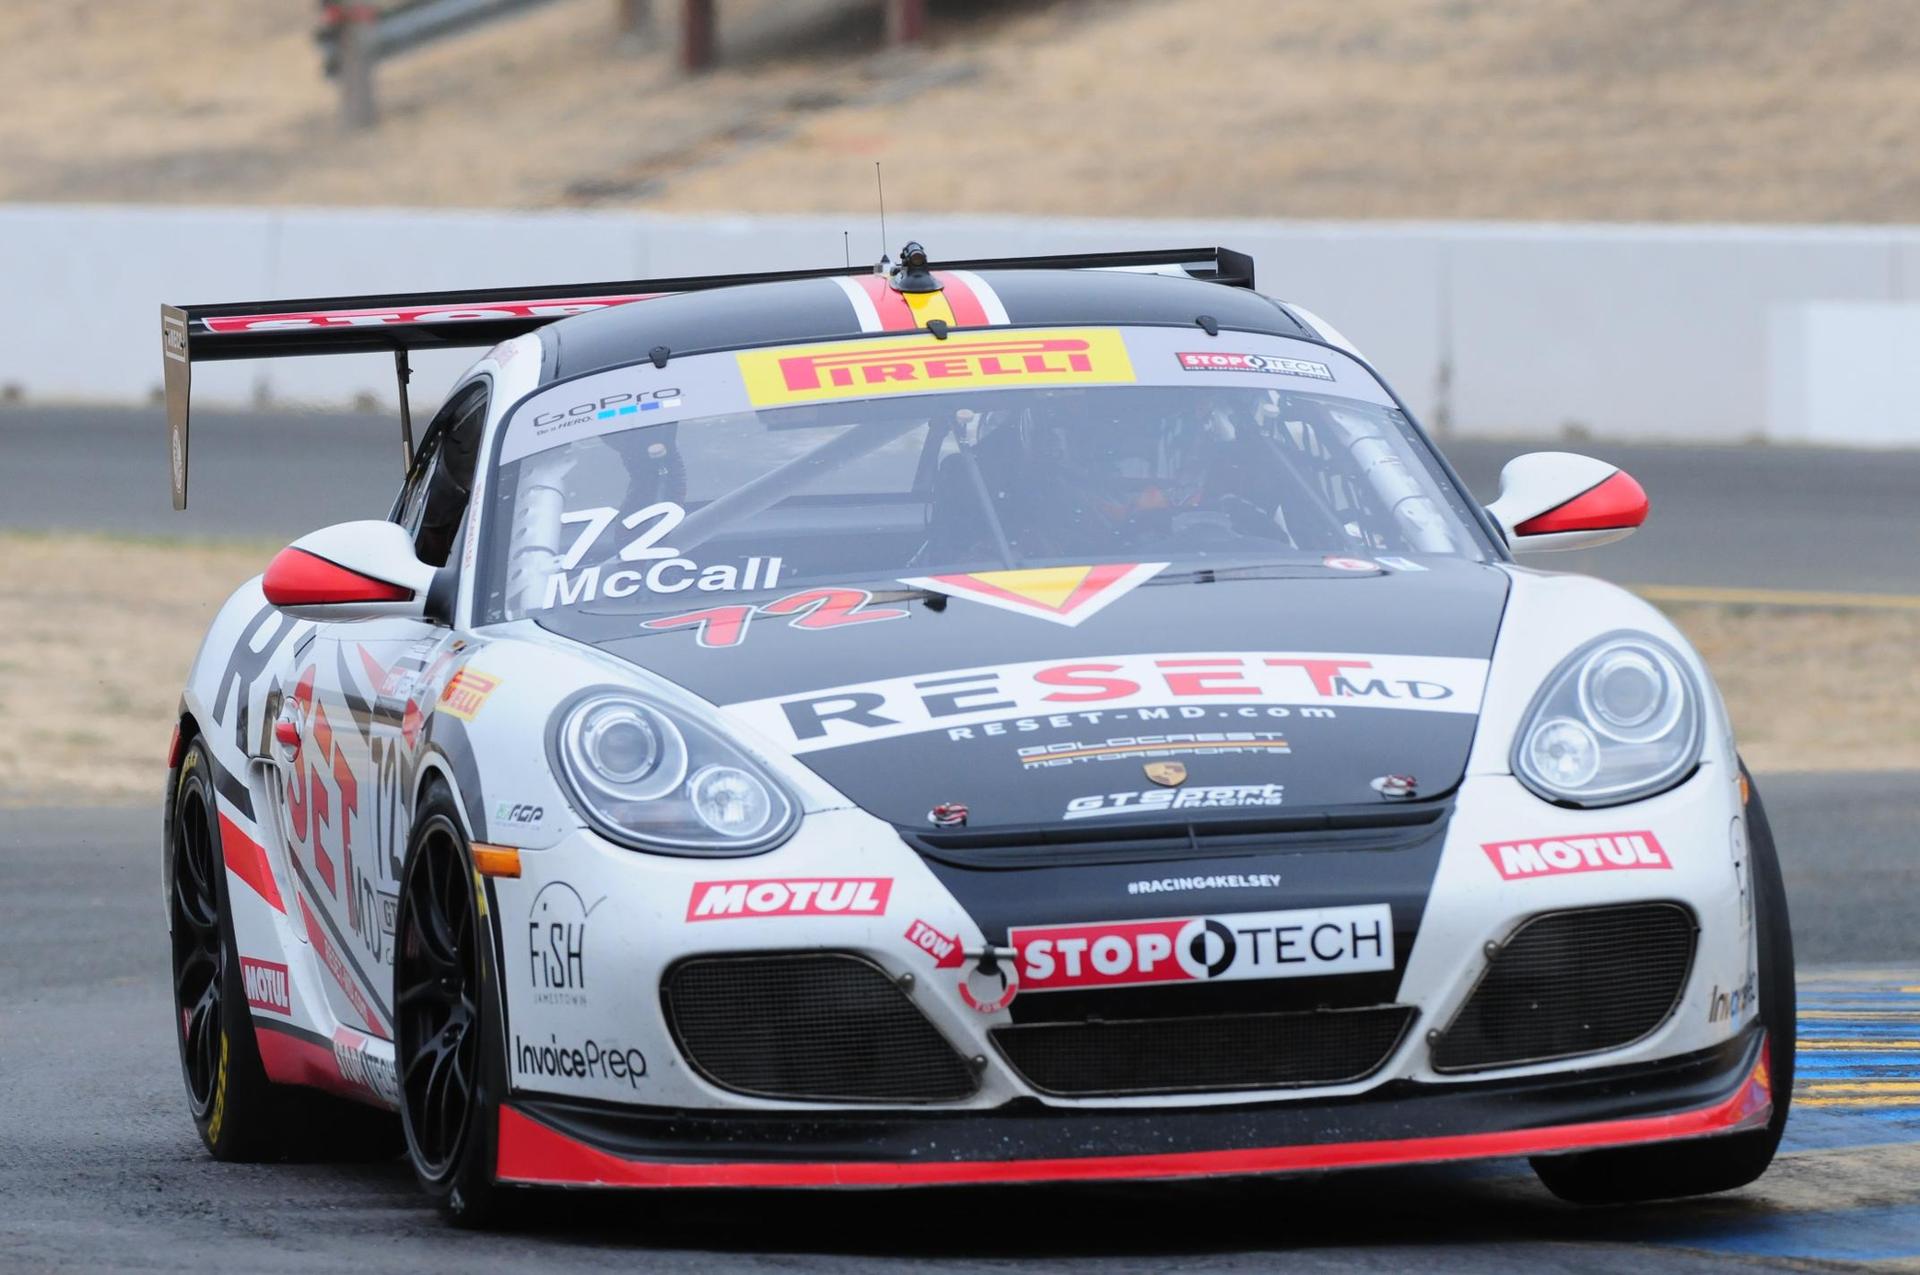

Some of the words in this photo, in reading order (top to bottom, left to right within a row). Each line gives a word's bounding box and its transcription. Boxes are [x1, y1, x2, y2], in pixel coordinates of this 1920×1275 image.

[777, 338, 1092, 391] PIRELLI
[1185, 355, 1244, 367] STOP
[1268, 358, 1326, 375] TECH
[533, 388, 681, 427] GoPro
[560, 501, 686, 570] 72
[541, 557, 783, 609] McCall
[780, 656, 1374, 741] RESET
[1333, 675, 1455, 702] MD
[949, 704, 1337, 743] RESET-MD.com
[1024, 746, 1292, 770] MOTORSPORTS
[1184, 797, 1283, 809] RACING
[1499, 836, 1663, 875] MOTUL
[694, 881, 881, 917] MOTUL
[1127, 873, 1281, 895] #RACING4KELSEY
[911, 922, 956, 960] TOW
[1023, 931, 1174, 977] STOP
[1233, 918, 1385, 966] TECH
[245, 964, 289, 1009] MOTUL
[516, 1033, 648, 1090] InvoicePrep
